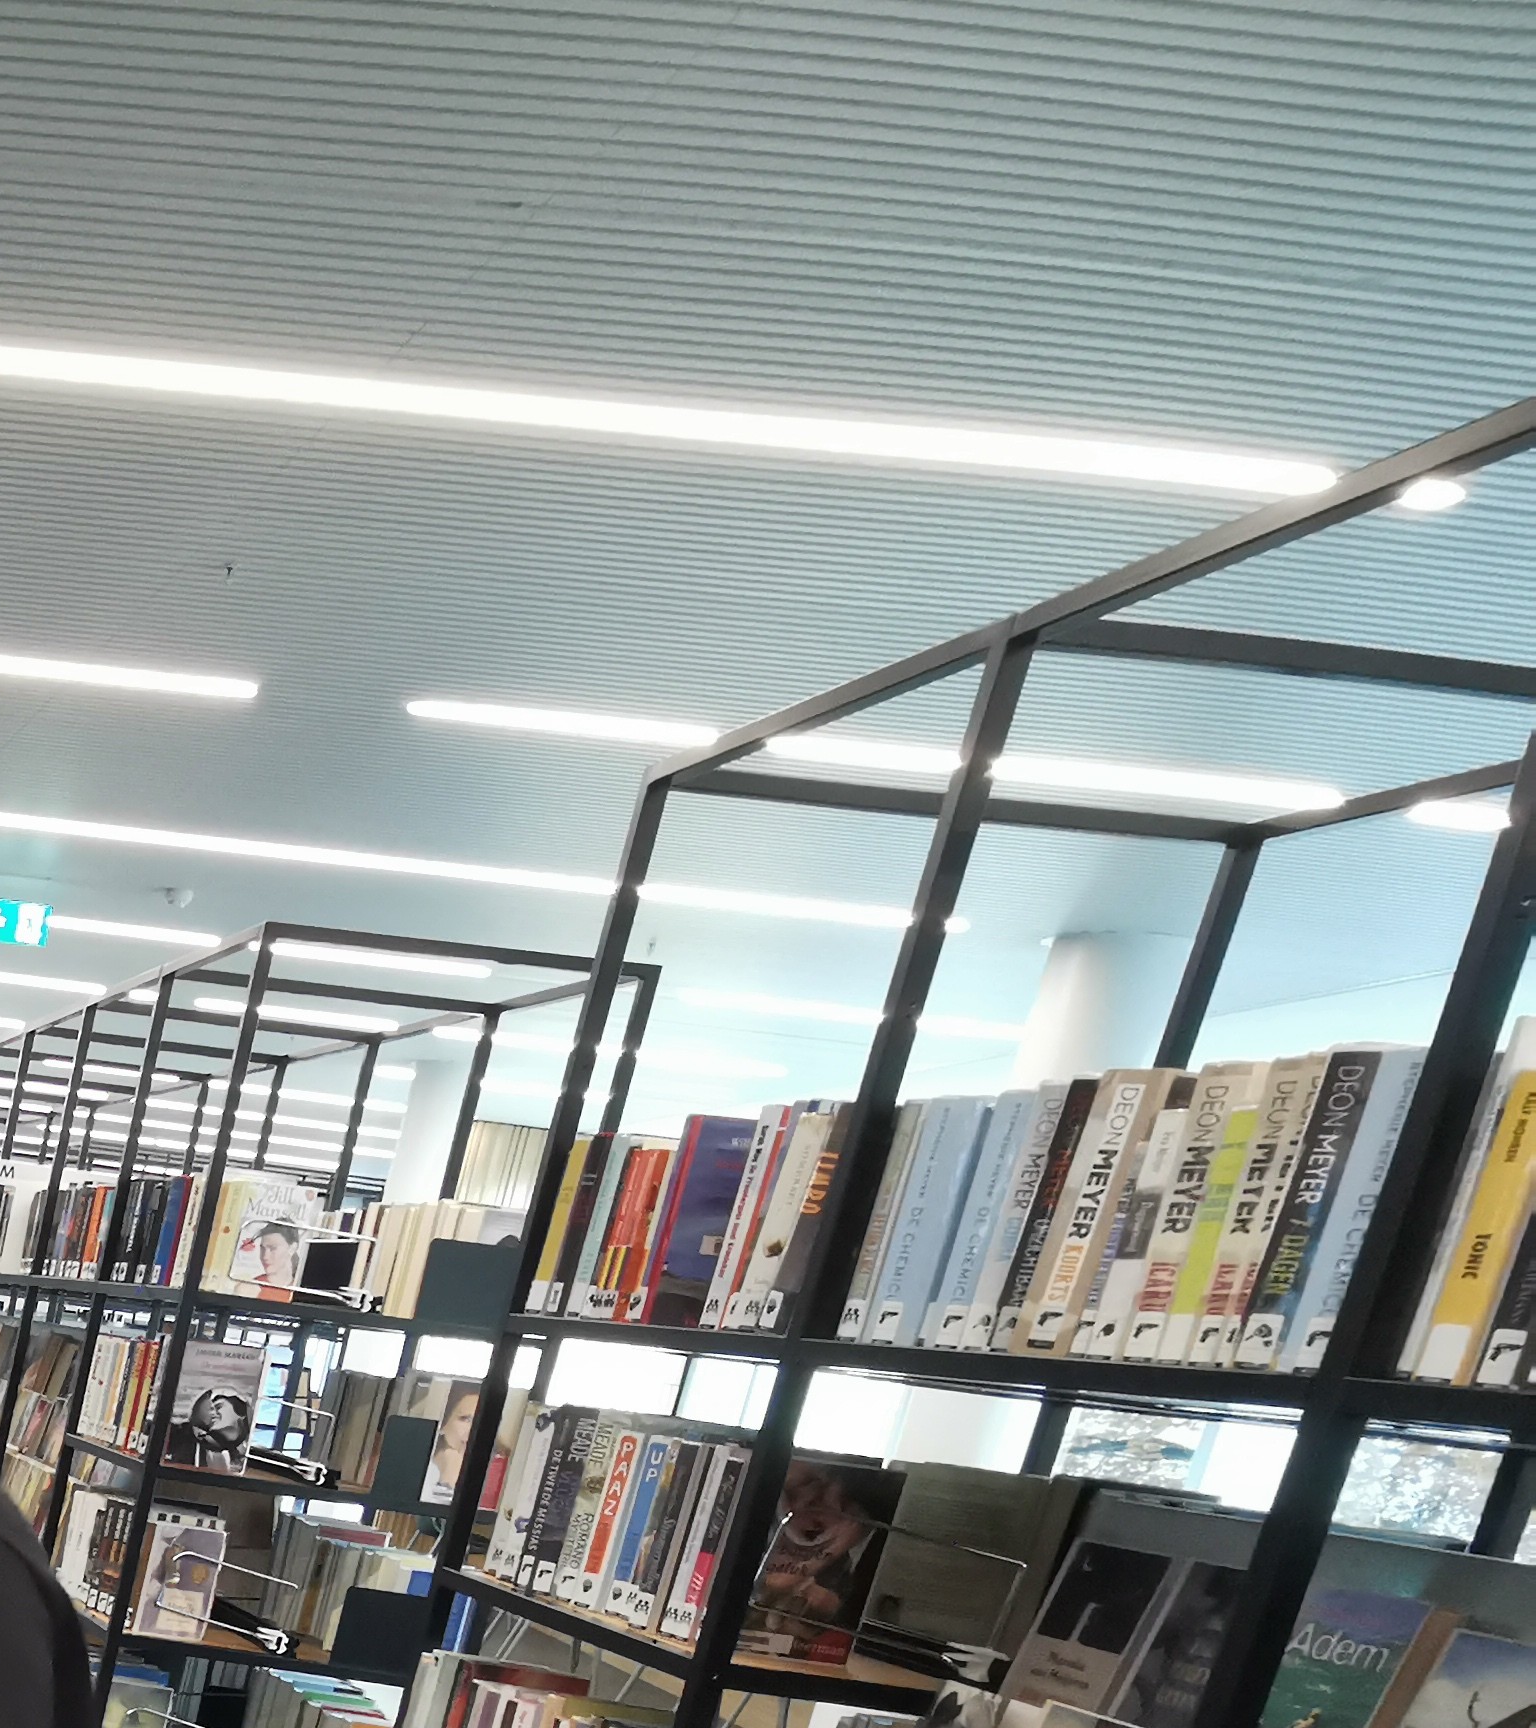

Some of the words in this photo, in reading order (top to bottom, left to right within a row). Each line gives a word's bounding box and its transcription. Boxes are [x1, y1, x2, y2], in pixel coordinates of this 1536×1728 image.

[1033, 1098, 1062, 1149] DEON
[1104, 1087, 1140, 1146] DEON
[1191, 1086, 1228, 1146] DEON
[1266, 1080, 1298, 1139] DEON
[1321, 1065, 1366, 1128] DEON
[0, 1162, 15, 1180] M
[1013, 1153, 1046, 1208] MEYER
[1069, 1149, 1118, 1240] MEYER
[1162, 1146, 1216, 1234] MEYER
[1230, 1143, 1278, 1235] MEYER
[1294, 1133, 1338, 1205] MEYER
[248, 1197, 307, 1220] Mansell
[911, 1207, 924, 1227] DE
[1048, 1244, 1084, 1302] KOORTS
[1461, 1233, 1492, 1280] TONIC
[573, 1418, 597, 1462] MEADE
[588, 1423, 614, 1470] MEADE
[645, 1451, 664, 1482] UP
[602, 1440, 635, 1516] PAAZ
[528, 1506, 548, 1552] MESSIAS
[569, 1512, 595, 1570] ROMANO
[1285, 1623, 1389, 1674] Adem
